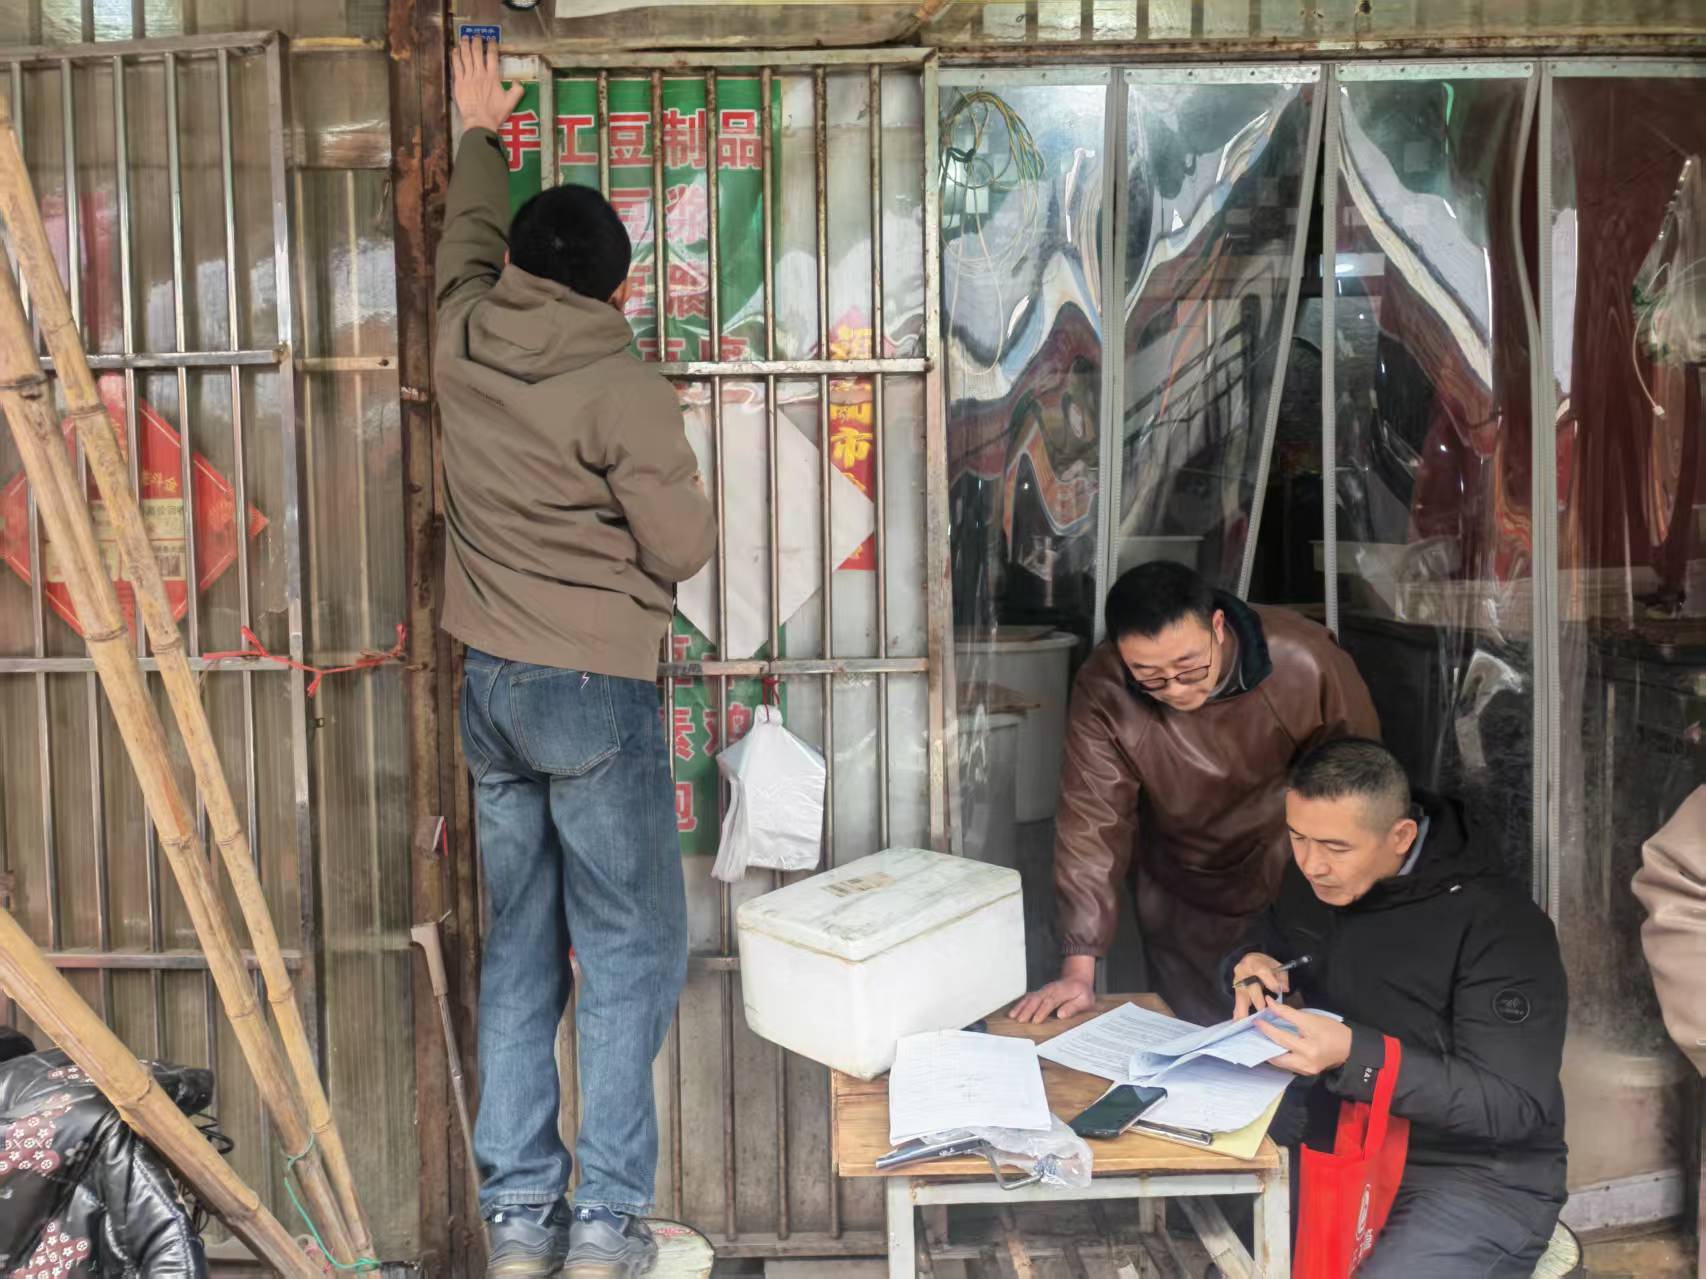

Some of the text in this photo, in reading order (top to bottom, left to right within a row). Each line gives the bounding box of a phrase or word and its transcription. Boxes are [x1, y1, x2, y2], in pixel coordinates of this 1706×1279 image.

[496, 108, 763, 171] 手工豆制品
